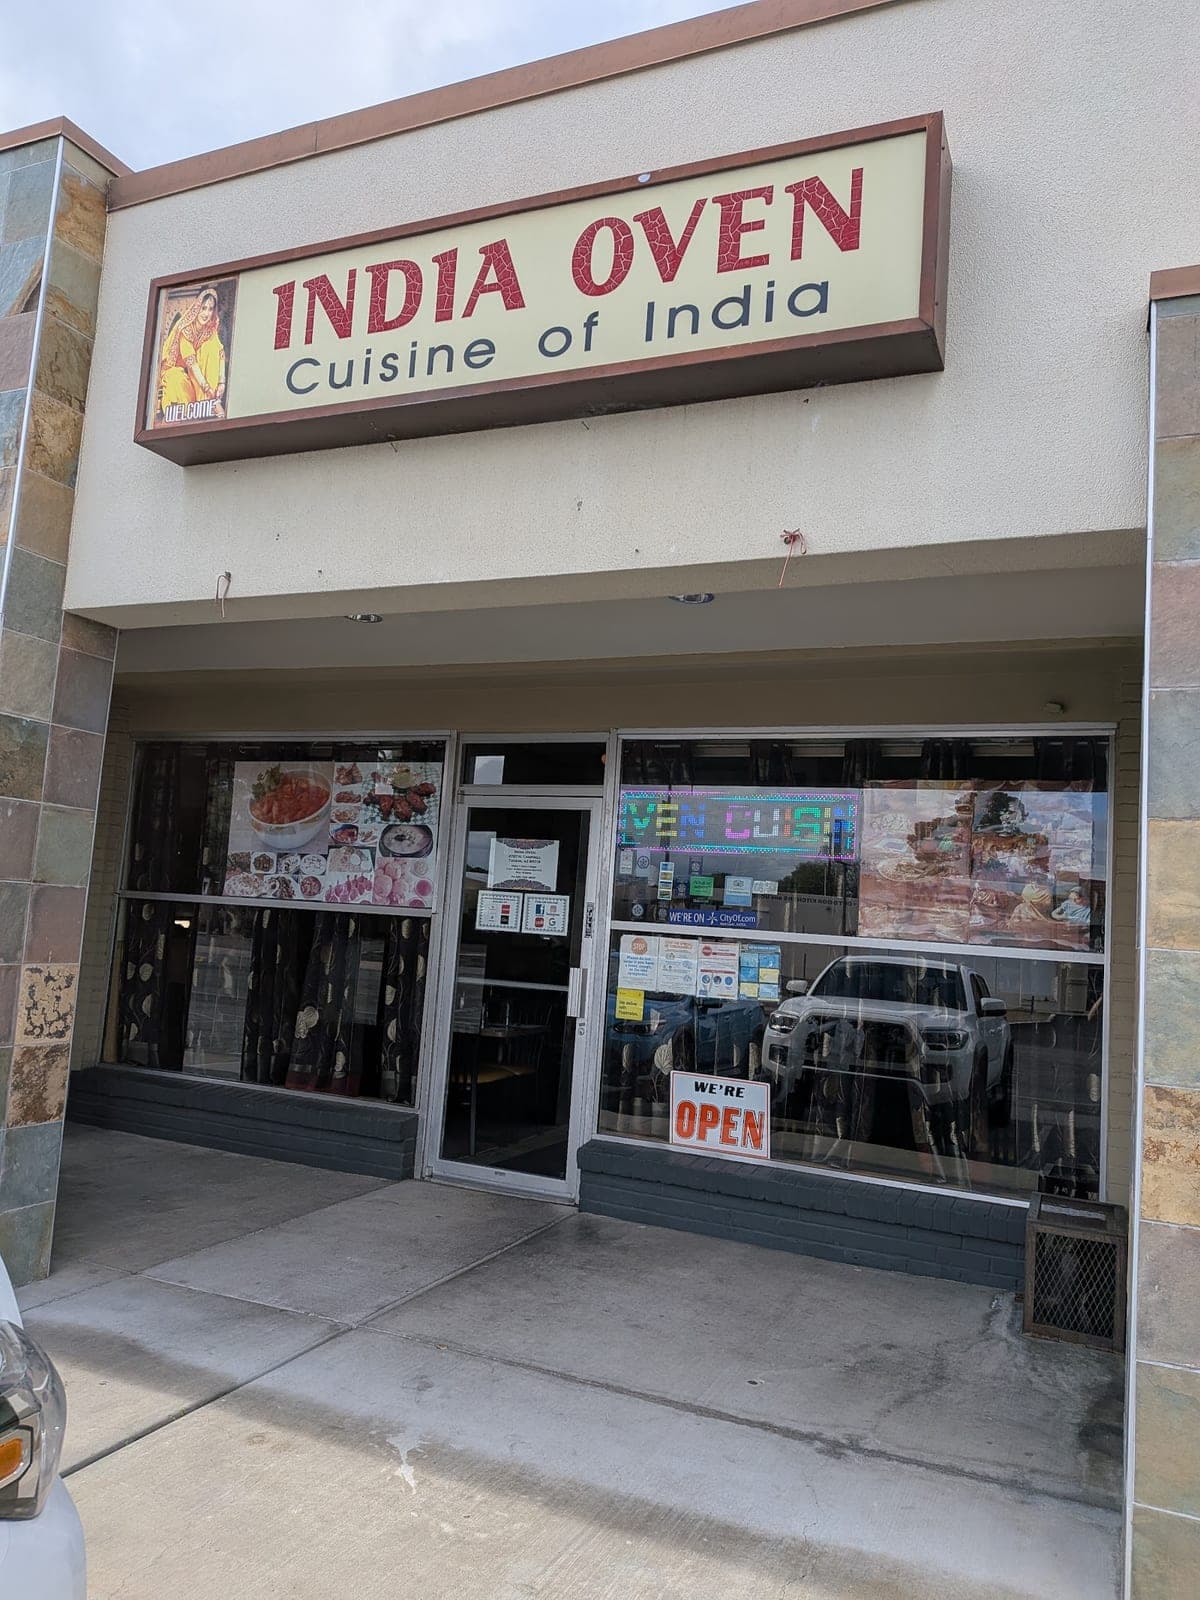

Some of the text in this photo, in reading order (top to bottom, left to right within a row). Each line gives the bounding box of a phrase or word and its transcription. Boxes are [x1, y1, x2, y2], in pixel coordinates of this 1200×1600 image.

[272, 168, 864, 350] INDIA OVEN
[286, 280, 829, 395] Cuisine of India
[165, 399, 217, 423] WELCOME
[669, 912, 756, 923] WE'RE ON CityOf.com
[694, 1081, 745, 1098] WE'RE
[676, 1100, 765, 1150] OPEN
